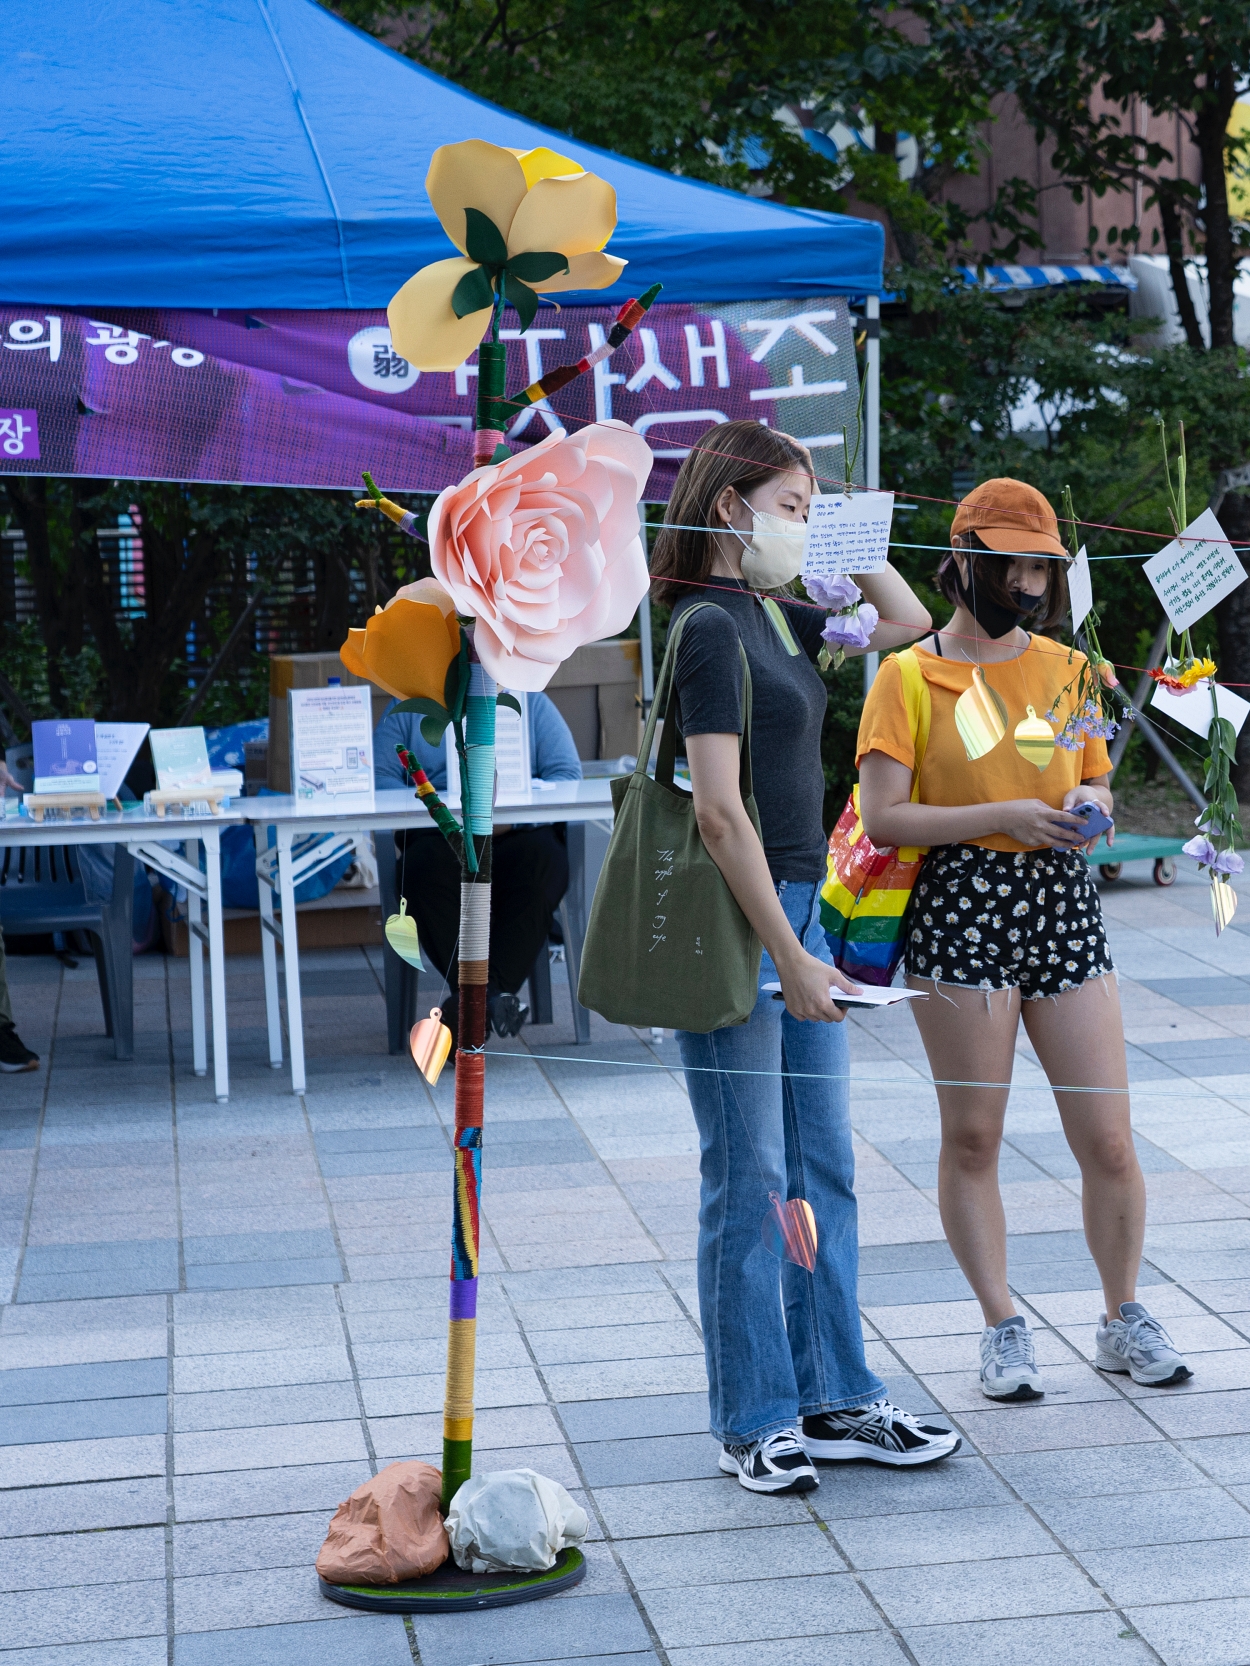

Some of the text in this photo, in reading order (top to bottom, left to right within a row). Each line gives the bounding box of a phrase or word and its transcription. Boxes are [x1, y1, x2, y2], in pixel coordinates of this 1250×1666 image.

[0, 315, 61, 362] 의
[372, 343, 409, 379] 弱
[430, 310, 849, 459] 자생존
[656, 849, 675, 862] The
[654, 865, 674, 881] apple
[652, 915, 667, 929] my
[648, 934, 667, 953] eye
